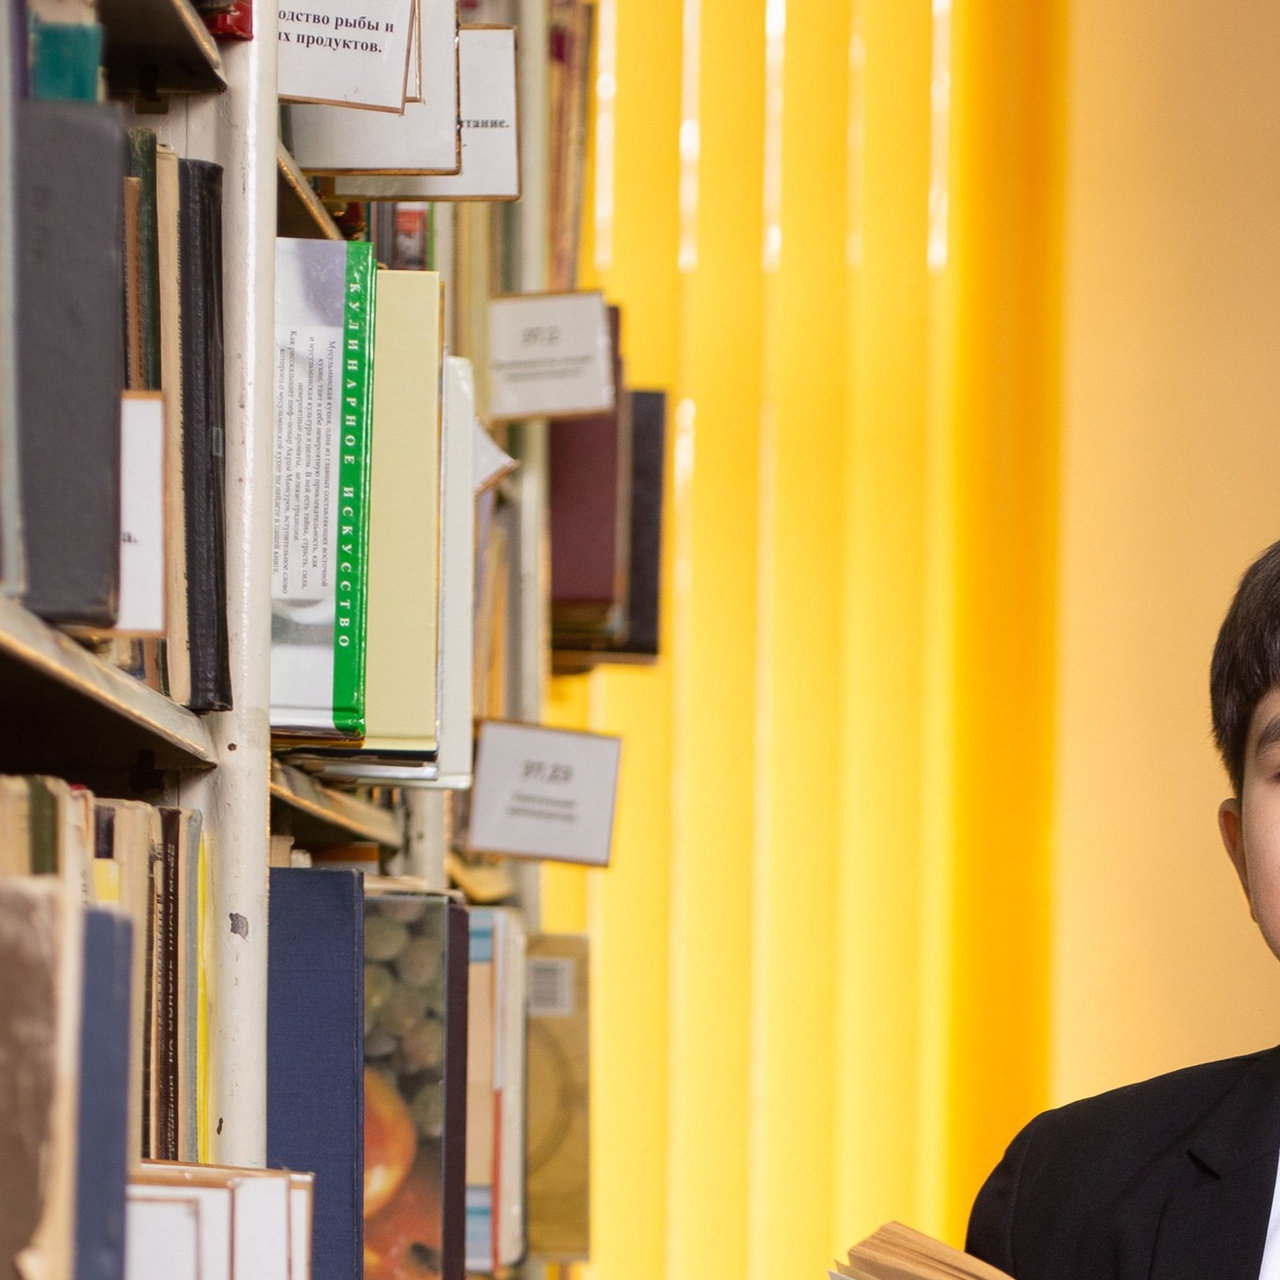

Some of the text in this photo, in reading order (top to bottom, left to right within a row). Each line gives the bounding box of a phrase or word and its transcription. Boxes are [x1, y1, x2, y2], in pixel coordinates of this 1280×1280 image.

[335, 14, 380, 32] рыбы
[384, 22, 395, 33] и
[296, 32, 383, 53] продуктов.
[338, 282, 361, 648] КУЛИНАРНОЕ ИСКУССТВО
